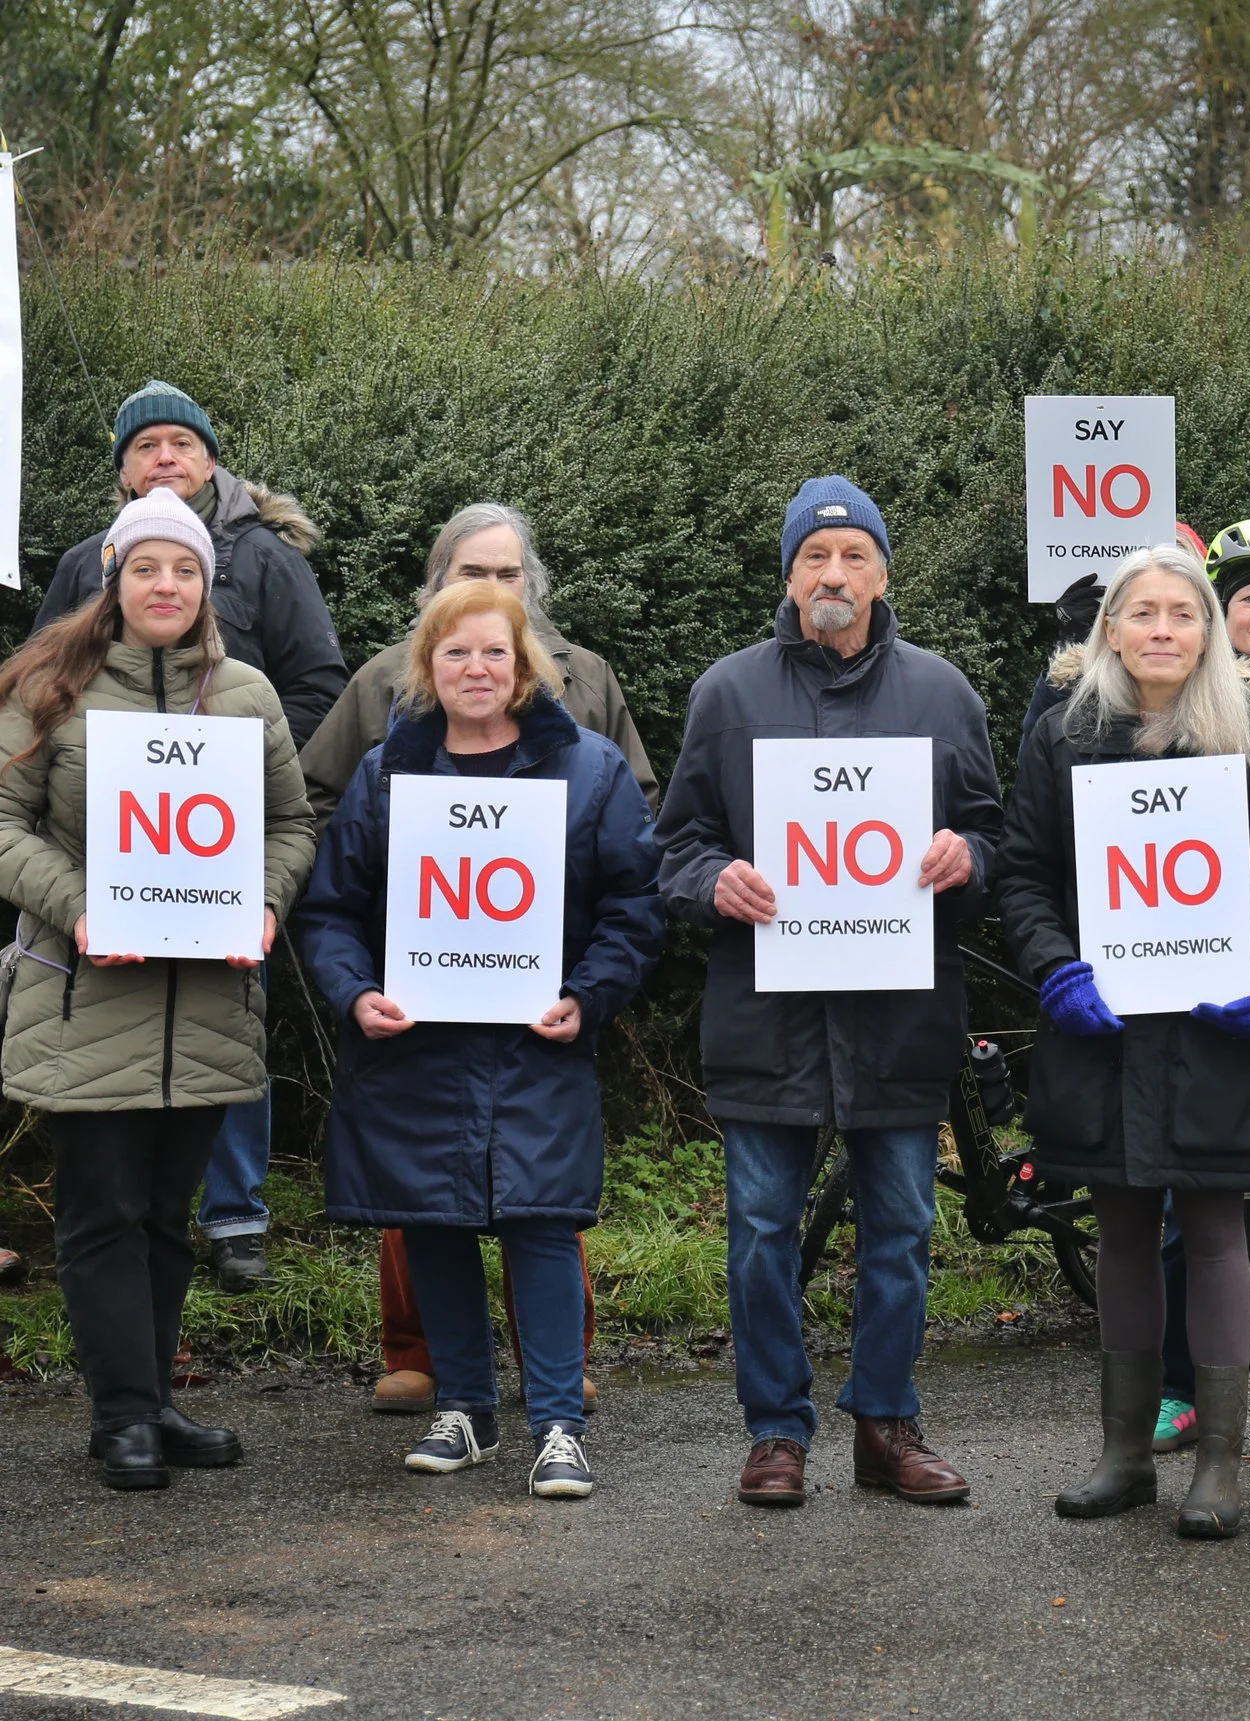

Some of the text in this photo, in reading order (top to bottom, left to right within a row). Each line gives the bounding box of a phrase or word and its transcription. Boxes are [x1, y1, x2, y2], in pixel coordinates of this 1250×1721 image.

[1075, 420, 1126, 441] SAY
[1053, 464, 1151, 519] NO
[1046, 545, 1067, 558] TO
[147, 739, 206, 766] SAY
[815, 766, 873, 793] SAY
[1131, 786, 1188, 815] SAY
[119, 790, 236, 858] NO
[448, 803, 508, 830] SAY
[787, 819, 904, 887] NO
[1107, 839, 1222, 910] NO
[110, 886, 242, 906] TO CRANSWICK
[419, 855, 536, 922] NO
[778, 918, 911, 936] TO CRANSWICK
[408, 951, 540, 970] TO CRANSWICK
[1102, 936, 1233, 960] TO CRANSWICK
